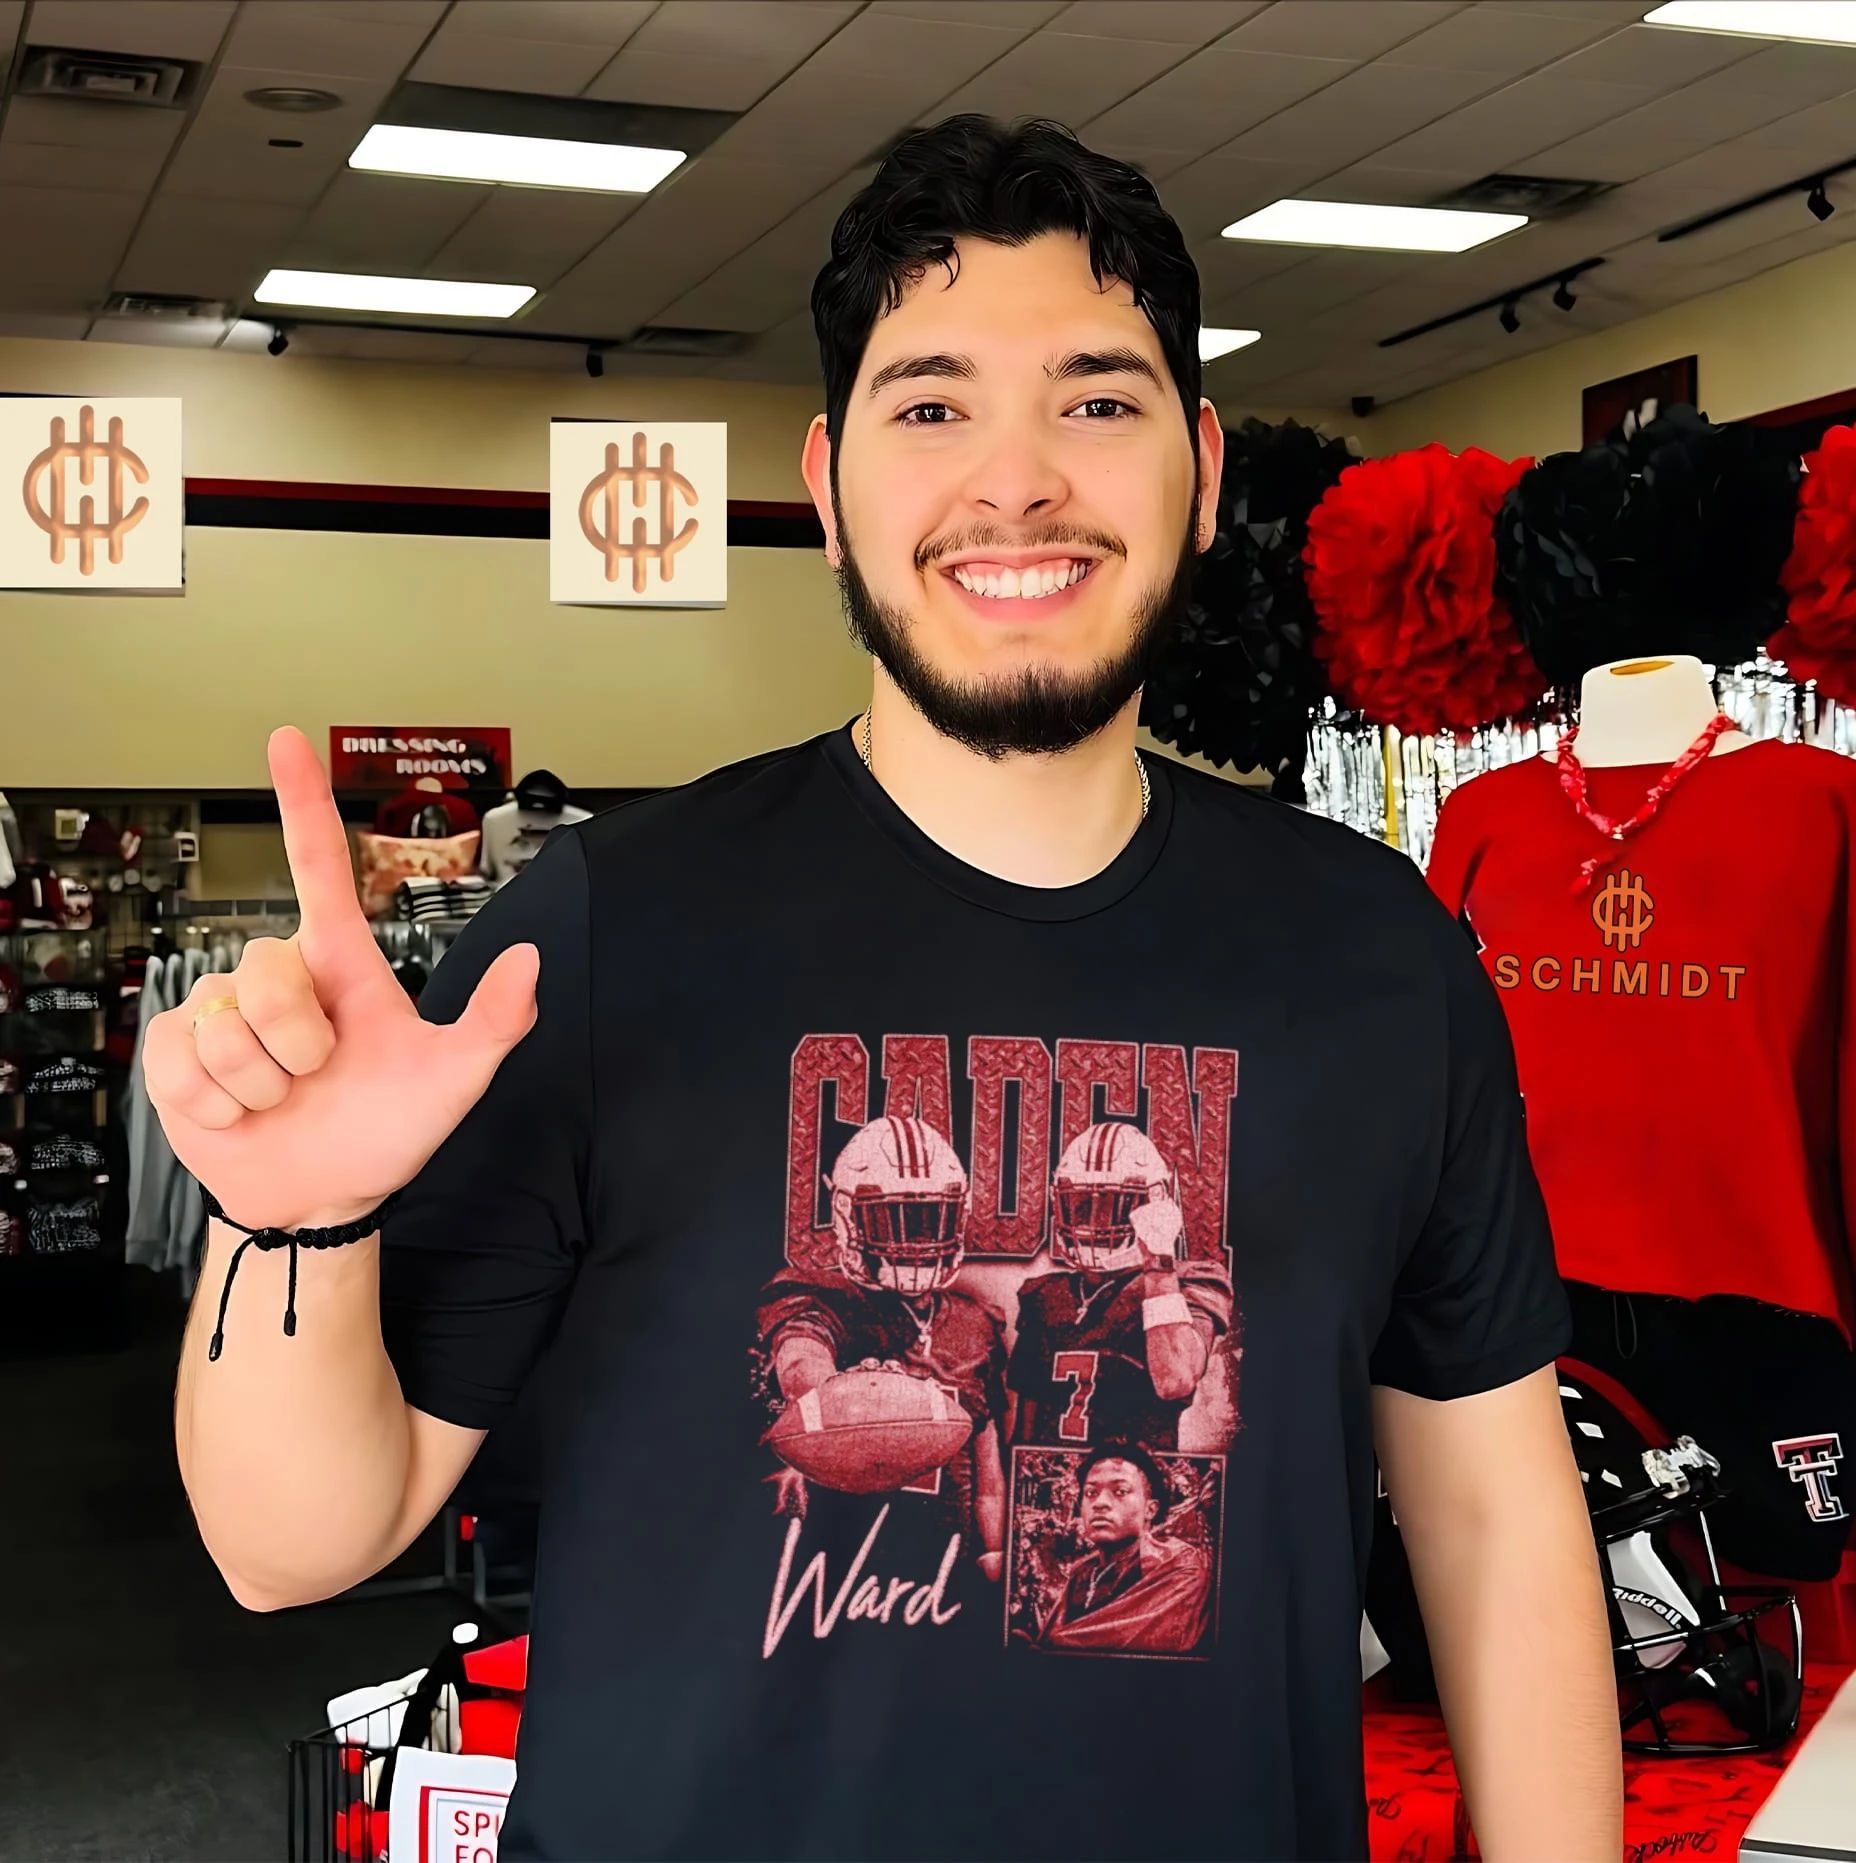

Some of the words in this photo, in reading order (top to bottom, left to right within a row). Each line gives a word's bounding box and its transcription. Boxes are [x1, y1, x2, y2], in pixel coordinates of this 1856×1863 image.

[342, 737, 467, 754] DRESSING
[396, 758, 487, 775] ROOMS
[1494, 954, 1746, 999] SCHMIDT
[1051, 1350, 1099, 1442] 7
[762, 1503, 961, 1659] Ward
